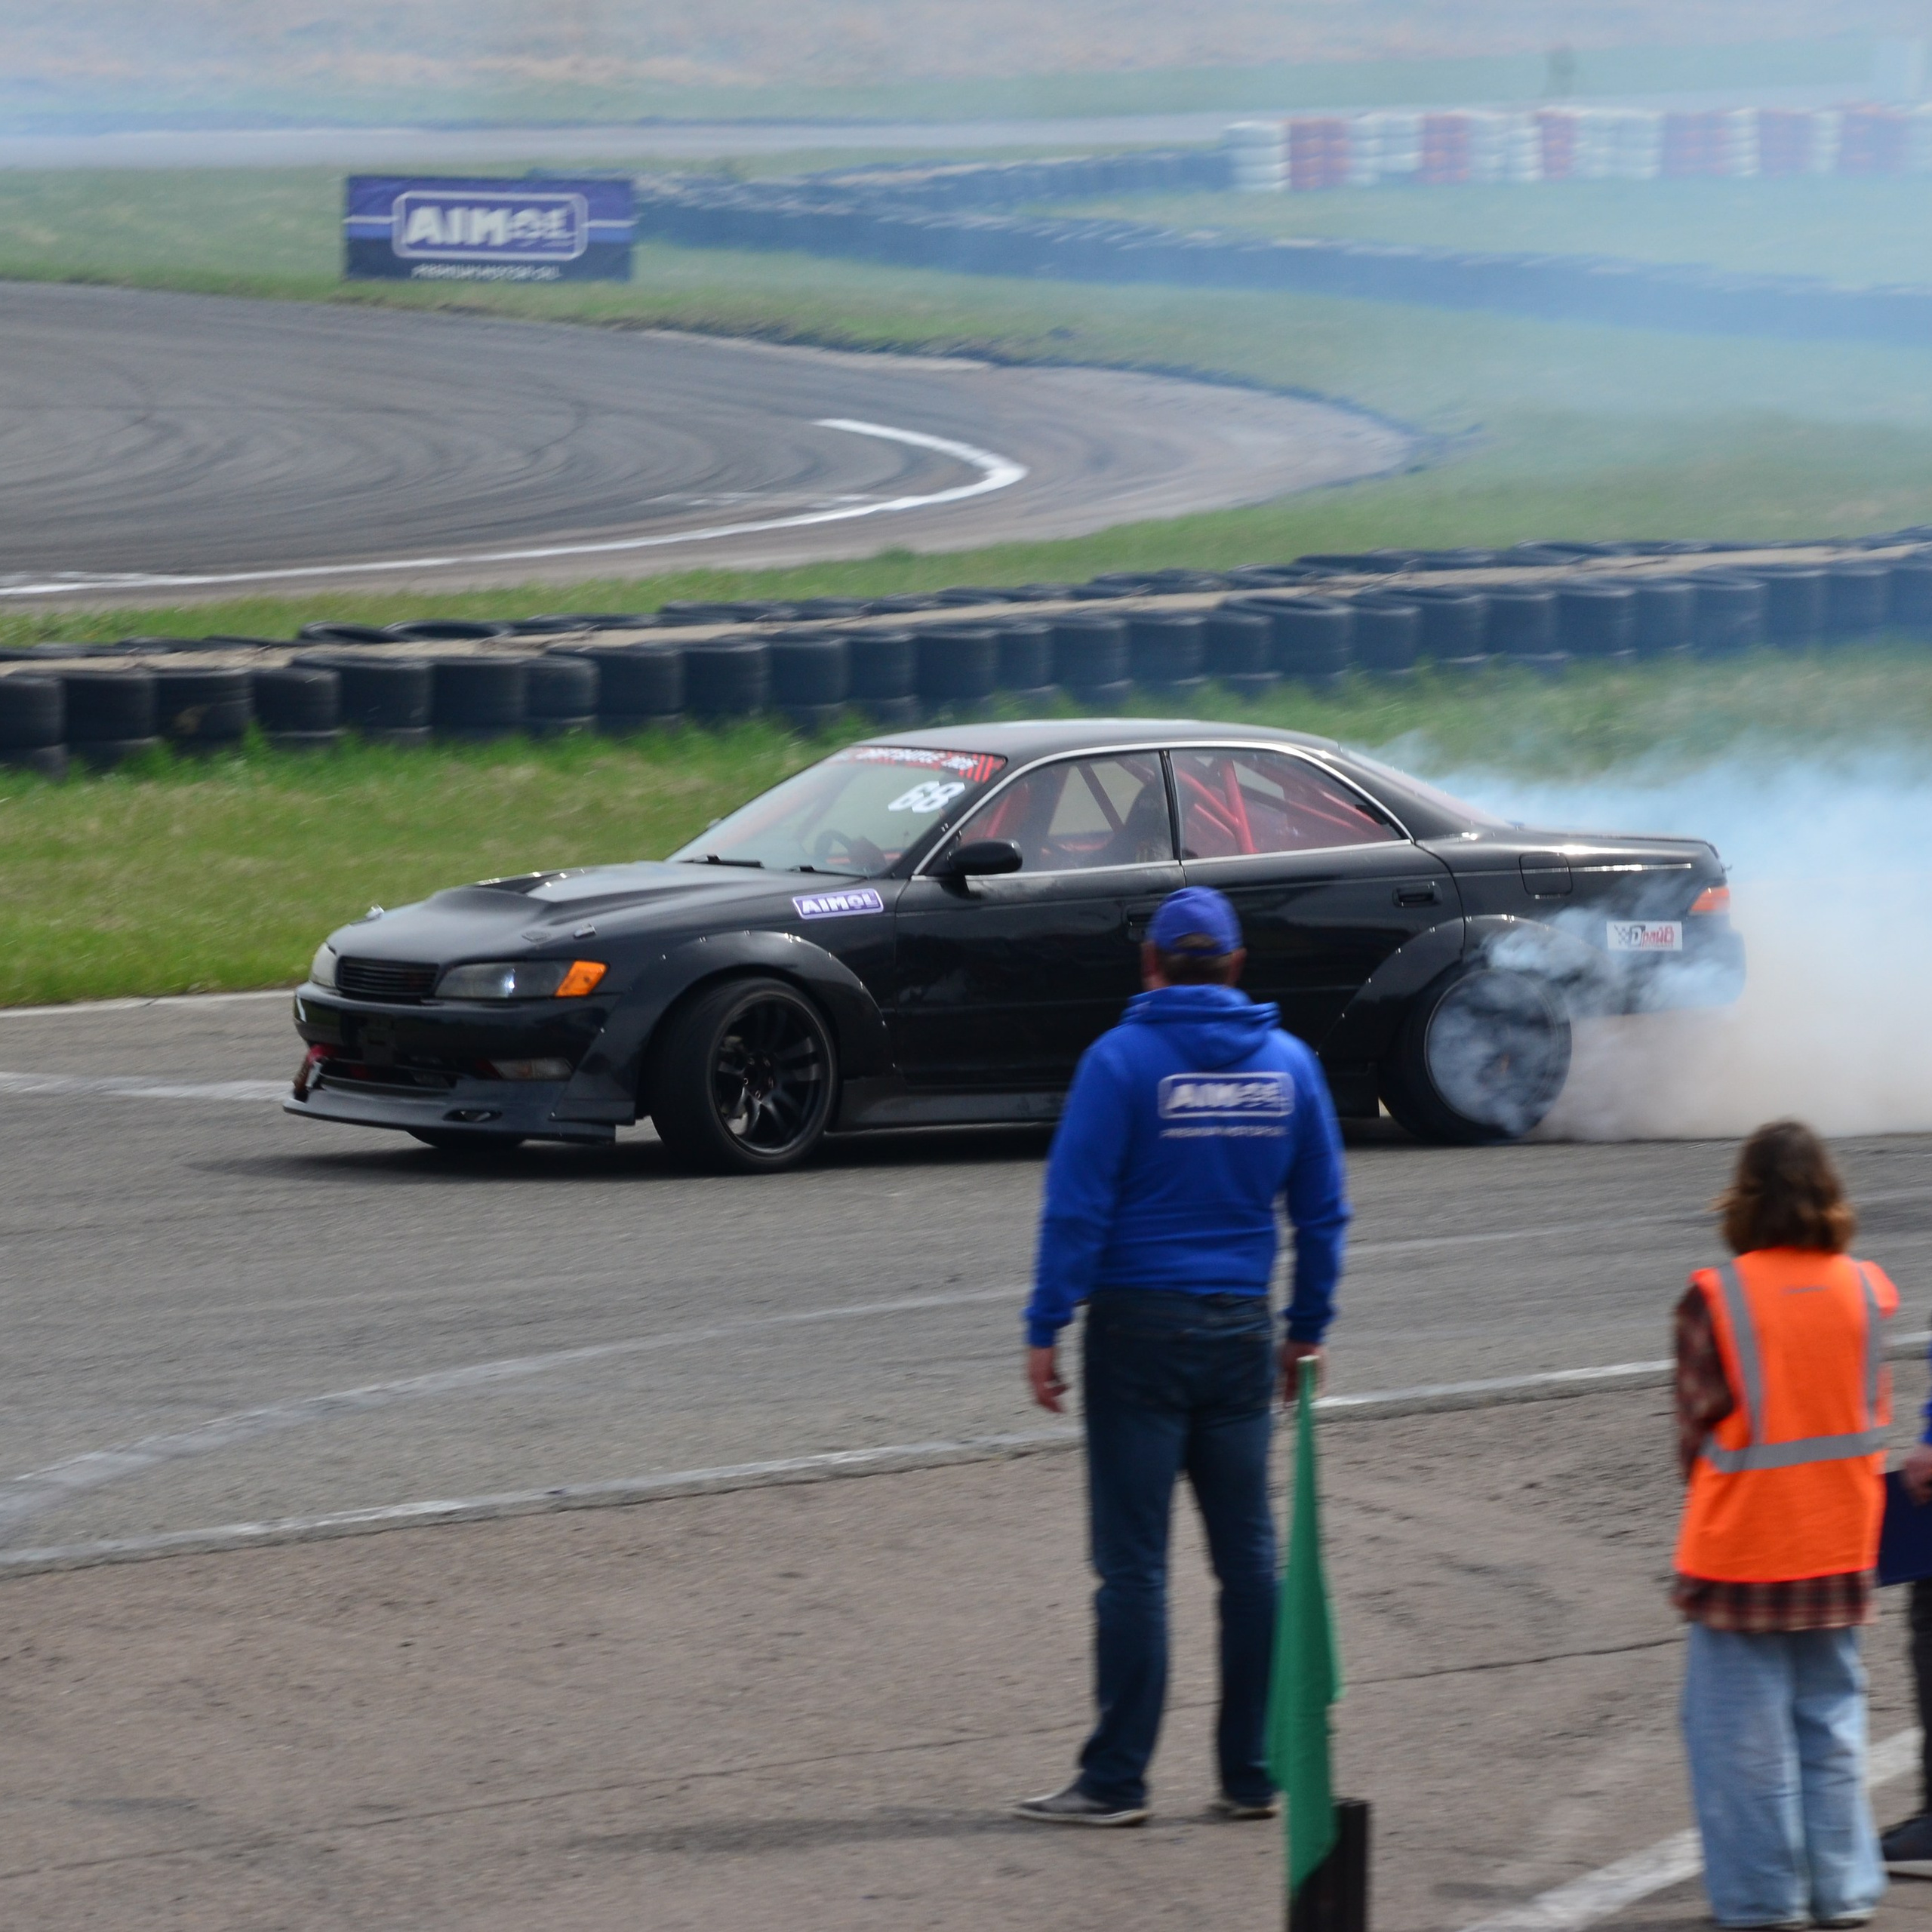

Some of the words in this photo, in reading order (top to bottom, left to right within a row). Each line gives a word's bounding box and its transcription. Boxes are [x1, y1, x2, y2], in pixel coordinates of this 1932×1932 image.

[405, 207, 577, 247] AIMOL
[888, 780, 964, 813] 68
[802, 893, 878, 914] AIMOL
